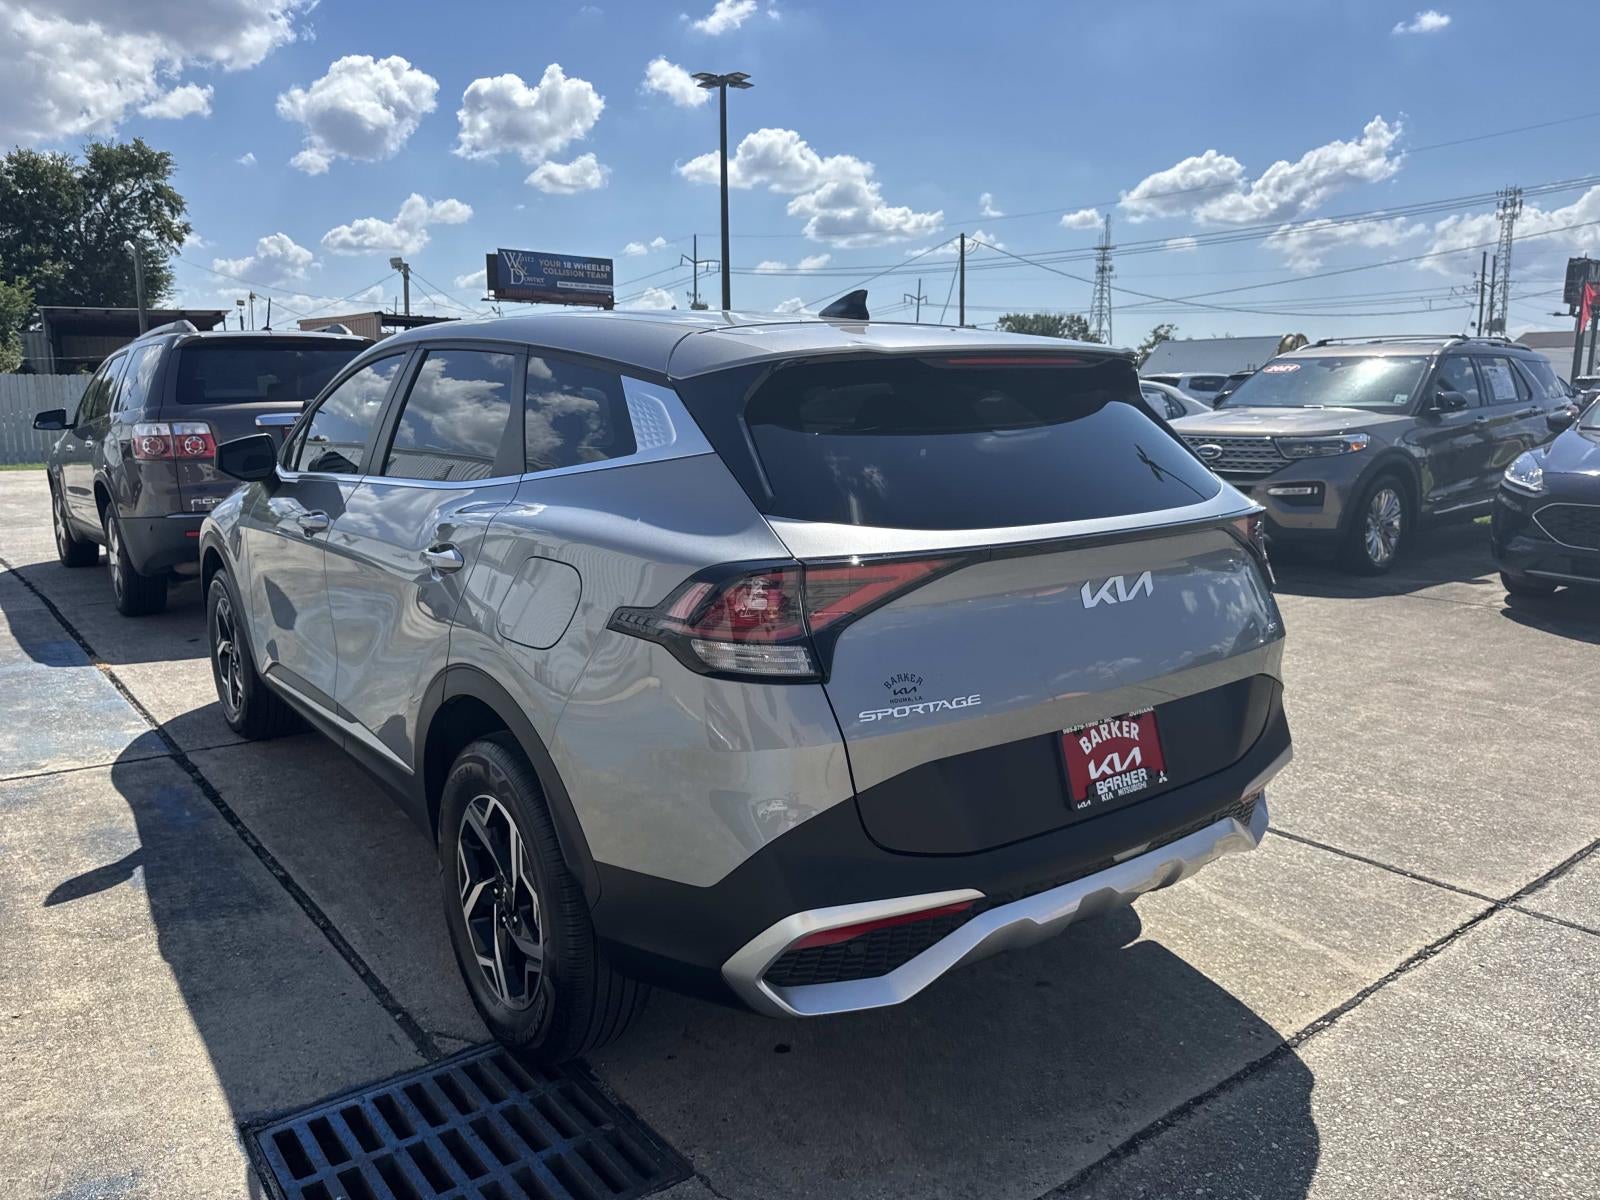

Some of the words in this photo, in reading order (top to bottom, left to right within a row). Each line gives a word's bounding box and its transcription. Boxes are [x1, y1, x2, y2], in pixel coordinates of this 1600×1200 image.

[539, 259, 561, 268] YOUR
[574, 263, 611, 273] WHEELER
[543, 268, 585, 278] COLLISION
[587, 271, 608, 280] TEAM
[1080, 570, 1154, 609] KIA
[883, 672, 924, 690] BARKER
[893, 686, 917, 696] KIA
[858, 694, 981, 722] SPORTAGE
[1079, 720, 1140, 755] BARKER
[1088, 746, 1142, 780] KIA
[1101, 791, 1114, 802] KIA
[1118, 781, 1147, 796] MITSUBISHI
